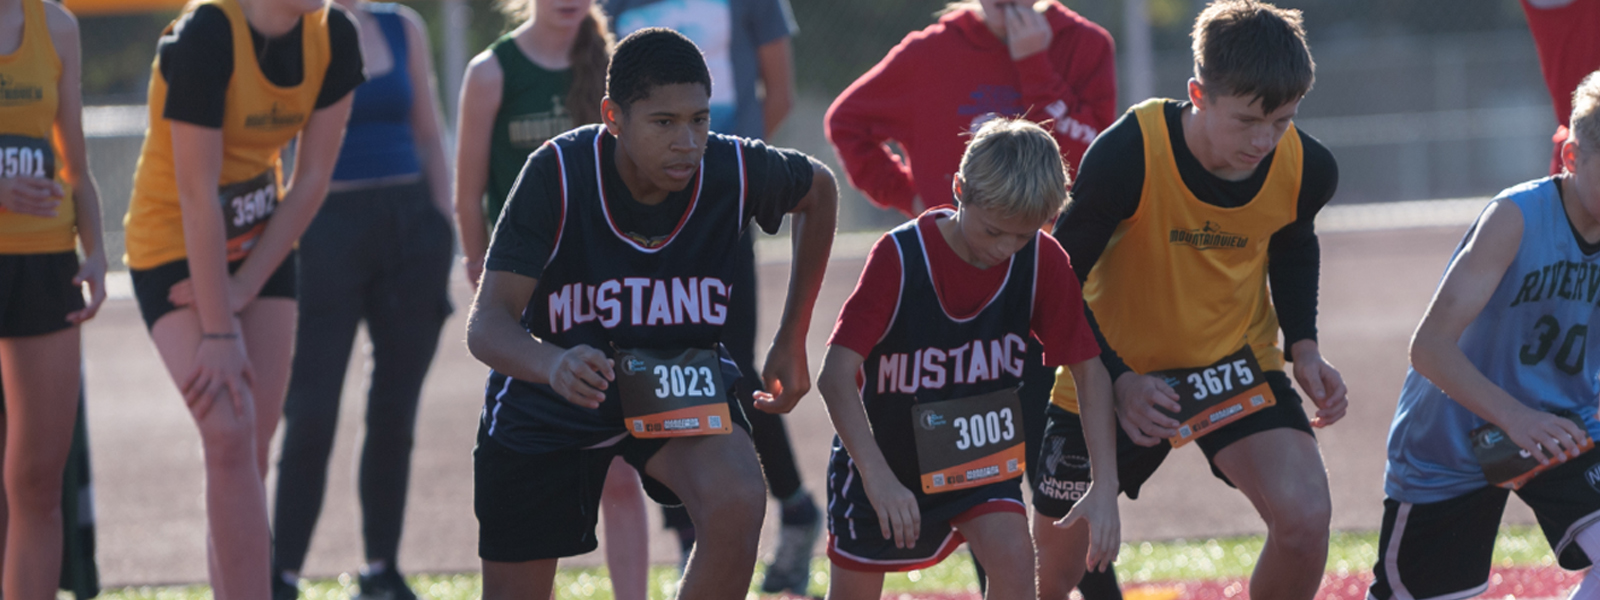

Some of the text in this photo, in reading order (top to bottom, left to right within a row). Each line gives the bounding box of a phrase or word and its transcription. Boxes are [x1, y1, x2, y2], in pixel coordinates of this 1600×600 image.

[231, 184, 275, 228] 3502
[1169, 229, 1249, 249] MOUNTAINVIEW
[548, 277, 734, 334] MUSTANG
[1509, 259, 1600, 308] RIVERV
[877, 332, 1027, 395] MUSTANG
[1519, 314, 1588, 376] 30
[653, 364, 716, 399] 3023
[1187, 358, 1255, 401] 3675
[953, 407, 1015, 451] 3003
[1038, 482, 1086, 501] ARMO
